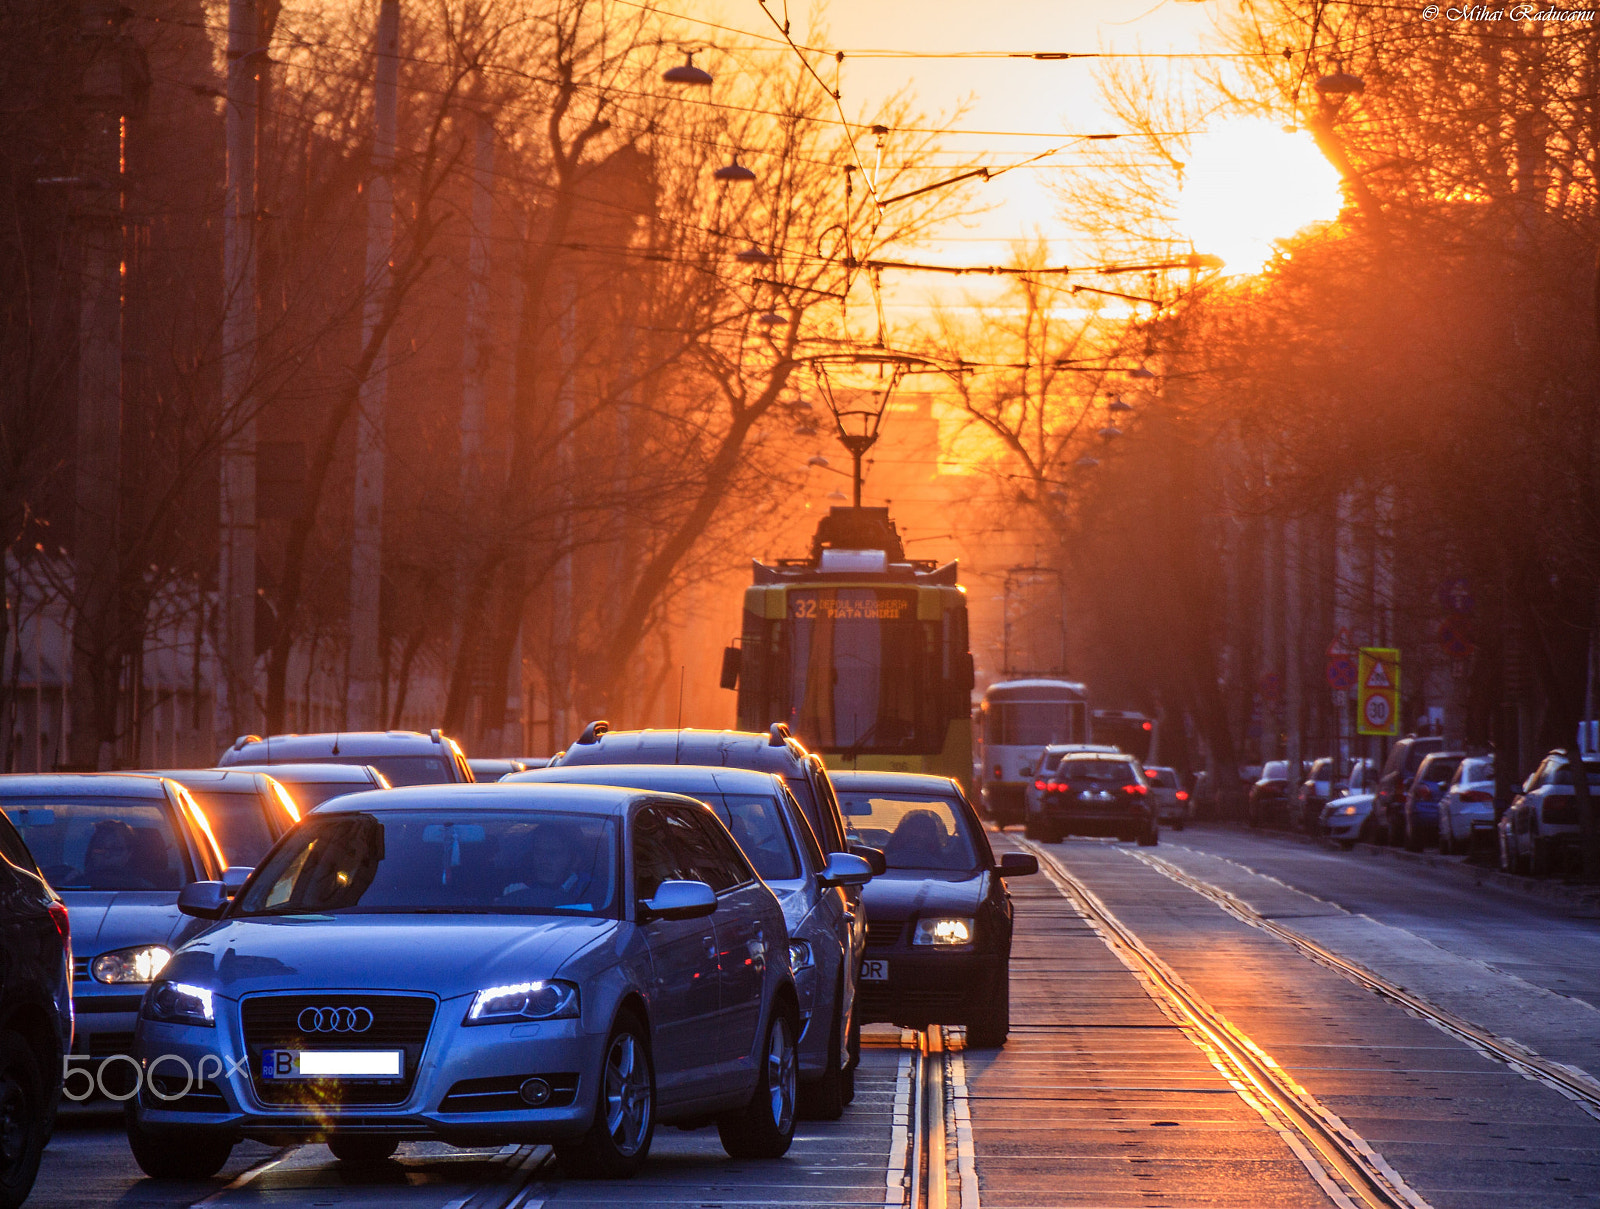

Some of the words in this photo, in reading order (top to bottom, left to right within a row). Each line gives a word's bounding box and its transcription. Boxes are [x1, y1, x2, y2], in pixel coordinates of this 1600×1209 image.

[795, 599, 817, 618] 32
[1369, 702, 1385, 719] 30
[276, 1052, 292, 1075] B
